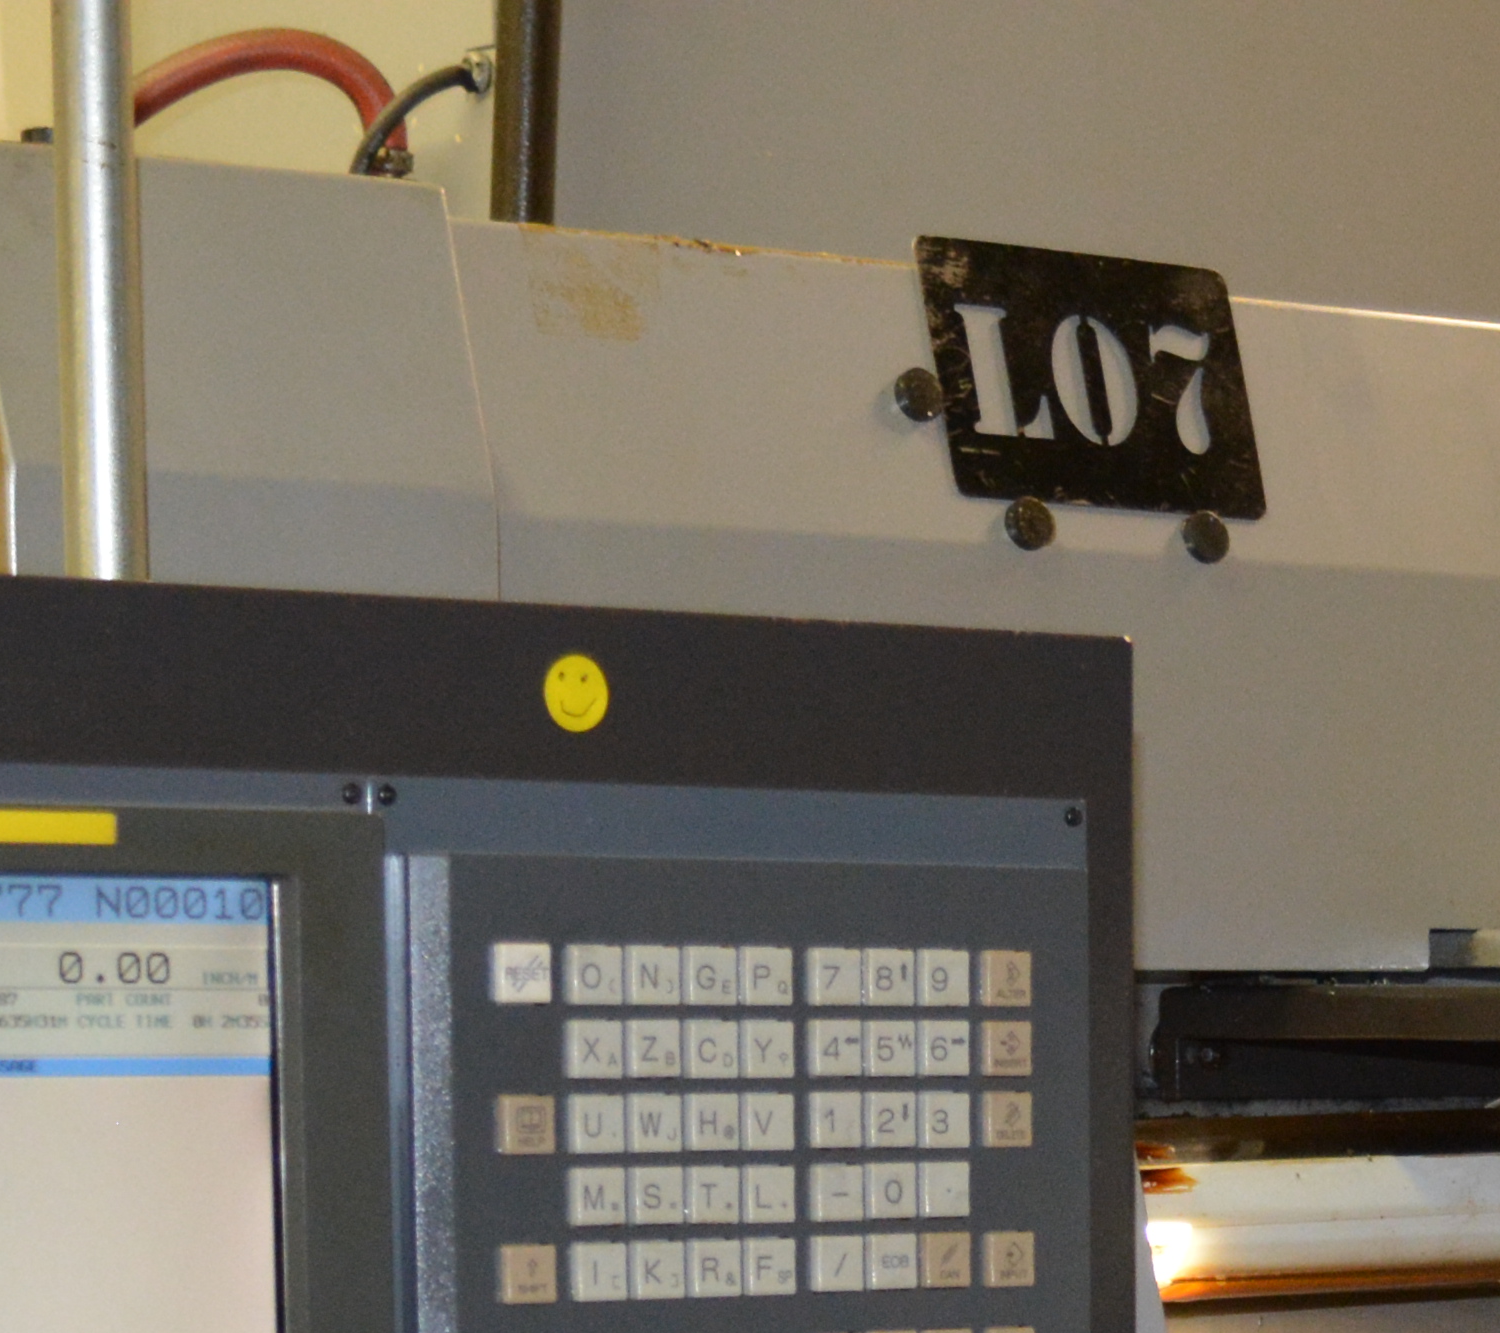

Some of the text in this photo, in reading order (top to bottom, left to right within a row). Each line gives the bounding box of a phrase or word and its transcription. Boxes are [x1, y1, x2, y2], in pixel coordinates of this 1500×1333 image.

[98, 886, 264, 920] N00010
[59, 951, 170, 984] 0.00
[505, 967, 550, 981] RESET
[640, 964, 658, 989] N
[696, 965, 716, 990] G
[753, 964, 771, 989] P
[823, 965, 841, 990] 7
[876, 966, 893, 991] 8
[931, 966, 948, 992] 9
[583, 1038, 600, 1063] X
[641, 1037, 658, 1061] Z
[699, 1038, 716, 1063] C
[755, 1038, 772, 1062] Y
[823, 1037, 840, 1060] 4
[877, 1037, 894, 1061] 5
[930, 1036, 948, 1061] 6
[584, 1112, 601, 1137] U
[640, 1112, 661, 1137] W
[700, 1111, 717, 1136] H
[755, 1111, 773, 1135] V
[824, 1108, 835, 1132] 1
[877, 1108, 895, 1133] 2
[931, 1110, 949, 1134] 3
[583, 1185, 604, 1210] M
[643, 1184, 661, 1209] S
[701, 1184, 717, 1208] T
[756, 1184, 772, 1208] L
[644, 1260, 661, 1283] K
[701, 1257, 719, 1281] R
[756, 1256, 773, 1280] F
